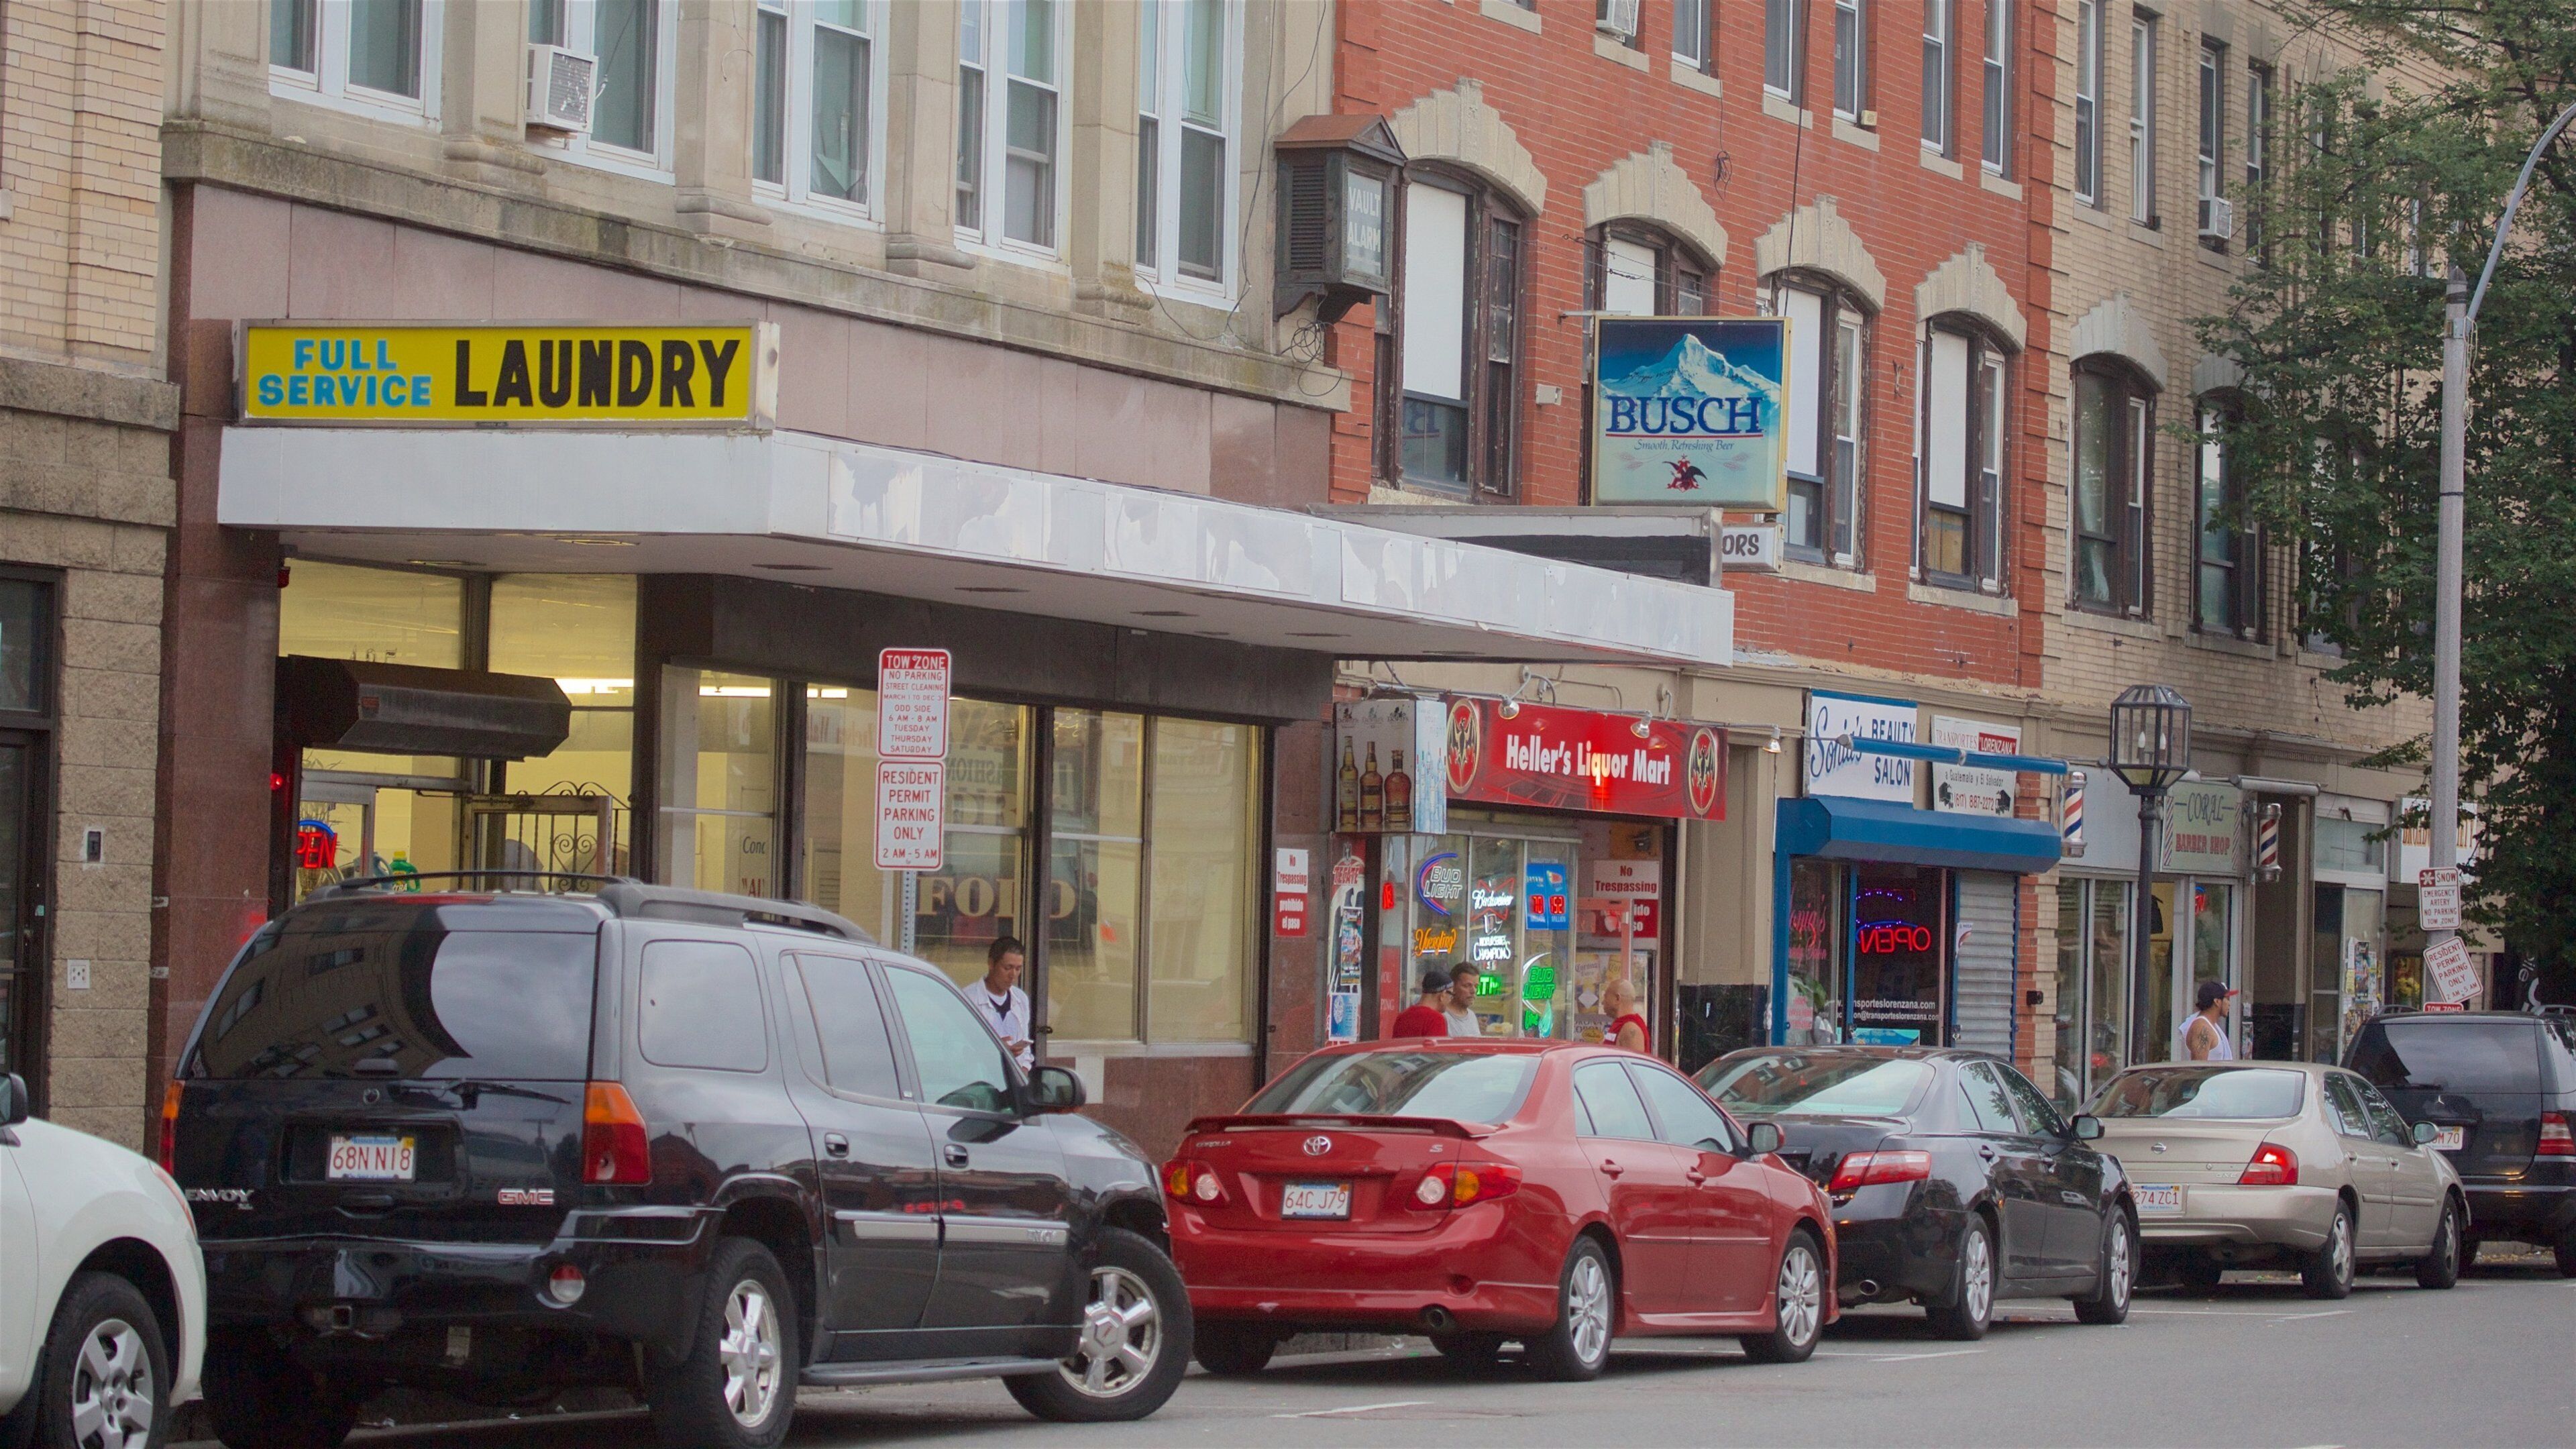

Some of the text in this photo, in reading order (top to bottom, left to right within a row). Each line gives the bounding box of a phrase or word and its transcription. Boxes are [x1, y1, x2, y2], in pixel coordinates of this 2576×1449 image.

[1348, 186, 1381, 217] VAULT
[1347, 221, 1381, 253] ALARM
[294, 339, 397, 370] FULL
[455, 339, 741, 407] LAUNDRY
[258, 374, 431, 407] SERVICE
[1606, 396, 1763, 434] BUSCH
[1671, 439, 1714, 453] Refreshing
[1715, 439, 1734, 451] Beer
[886, 655, 945, 669] TOW ZONE
[889, 671, 942, 681] NO PARKING
[885, 682, 944, 692] STREET CLEANING
[1872, 718, 1916, 743] BEAUTY
[1936, 730, 1978, 749] TRANSPORTES
[1506, 734, 1670, 786] Heller's Liquor Mart
[882, 771, 938, 785] RESIDENT
[1874, 756, 1911, 786] SALON
[889, 790, 931, 803] PERMIT
[884, 808, 935, 822] PARKING
[2188, 793, 2224, 826] CORAL
[894, 826, 924, 840] ONLY
[2175, 833, 2231, 855] BARBER SHOP
[882, 848, 888, 859] 2
[893, 848, 906, 859] AM
[914, 848, 920, 859] 5
[924, 849, 937, 859] AM
[1289, 854, 1296, 867] No
[1277, 871, 1307, 885] Trespassing
[1333, 865, 1360, 885] TECATE
[1430, 866, 1461, 883] BUD
[1620, 865, 1633, 877] No
[2436, 873, 2457, 883] SNOW
[1423, 881, 1462, 899] LIGHT
[1595, 880, 1657, 894] Trespassing
[2424, 889, 2455, 898] EMERGENCY
[2430, 898, 2450, 906] ARTERY
[2434, 907, 2457, 916] PARKING
[2428, 942, 2461, 962] RESIDENT
[2436, 954, 2461, 970] PERMIT
[1529, 967, 1554, 983] BUD
[2438, 962, 2468, 980] PARKING
[2449, 974, 2466, 987] ONLY
[1523, 983, 1556, 1000] LIGHT
[2447, 1132, 2459, 1144] 70
[333, 1146, 369, 1170] 68N
[184, 1188, 254, 1201] ENVOY
[498, 1189, 554, 1205] GMC
[1285, 1191, 1346, 1209] 64C J79
[2133, 1191, 2179, 1205] 274 ZC1
